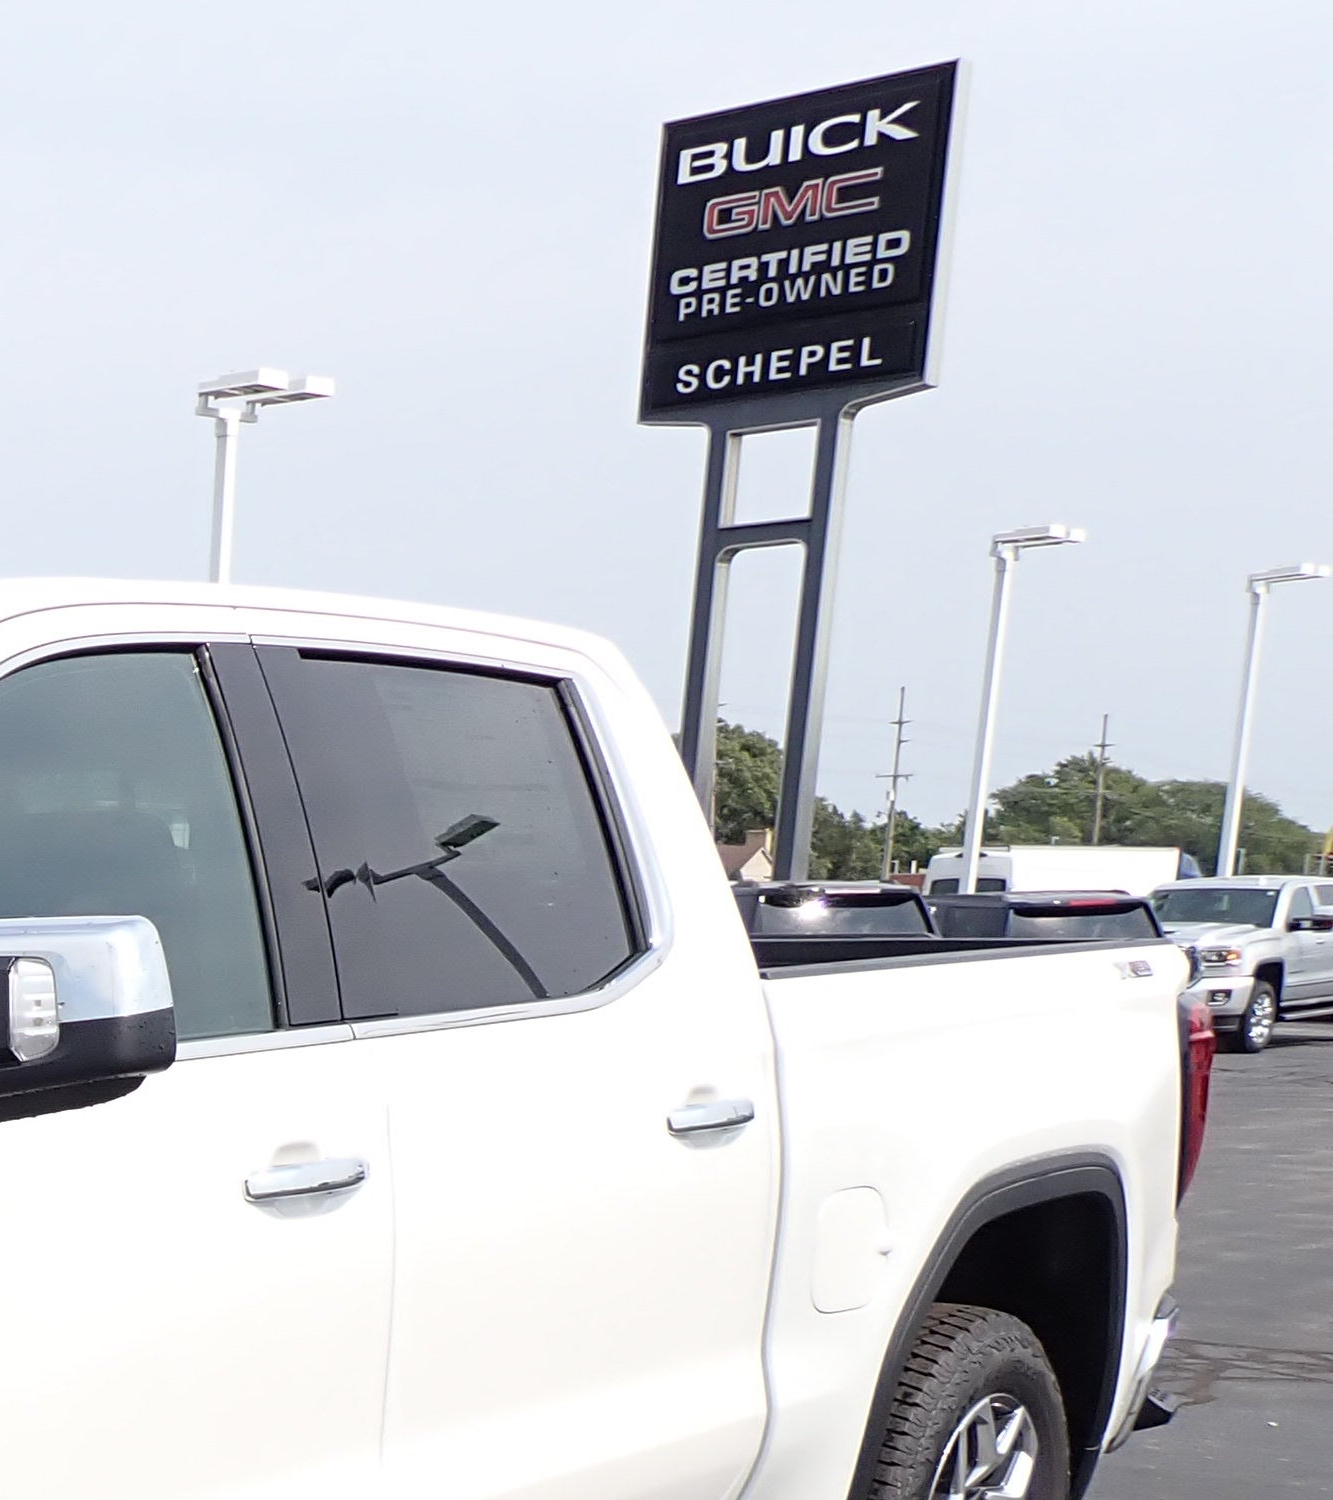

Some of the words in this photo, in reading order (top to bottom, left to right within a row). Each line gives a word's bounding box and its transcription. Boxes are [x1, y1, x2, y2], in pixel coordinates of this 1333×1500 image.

[677, 101, 921, 185] BUICK
[703, 167, 883, 240] GMC
[670, 230, 911, 296] CERTIFIED
[678, 263, 896, 322] PRE-OWNED
[676, 337, 883, 394] SCHEPEL
